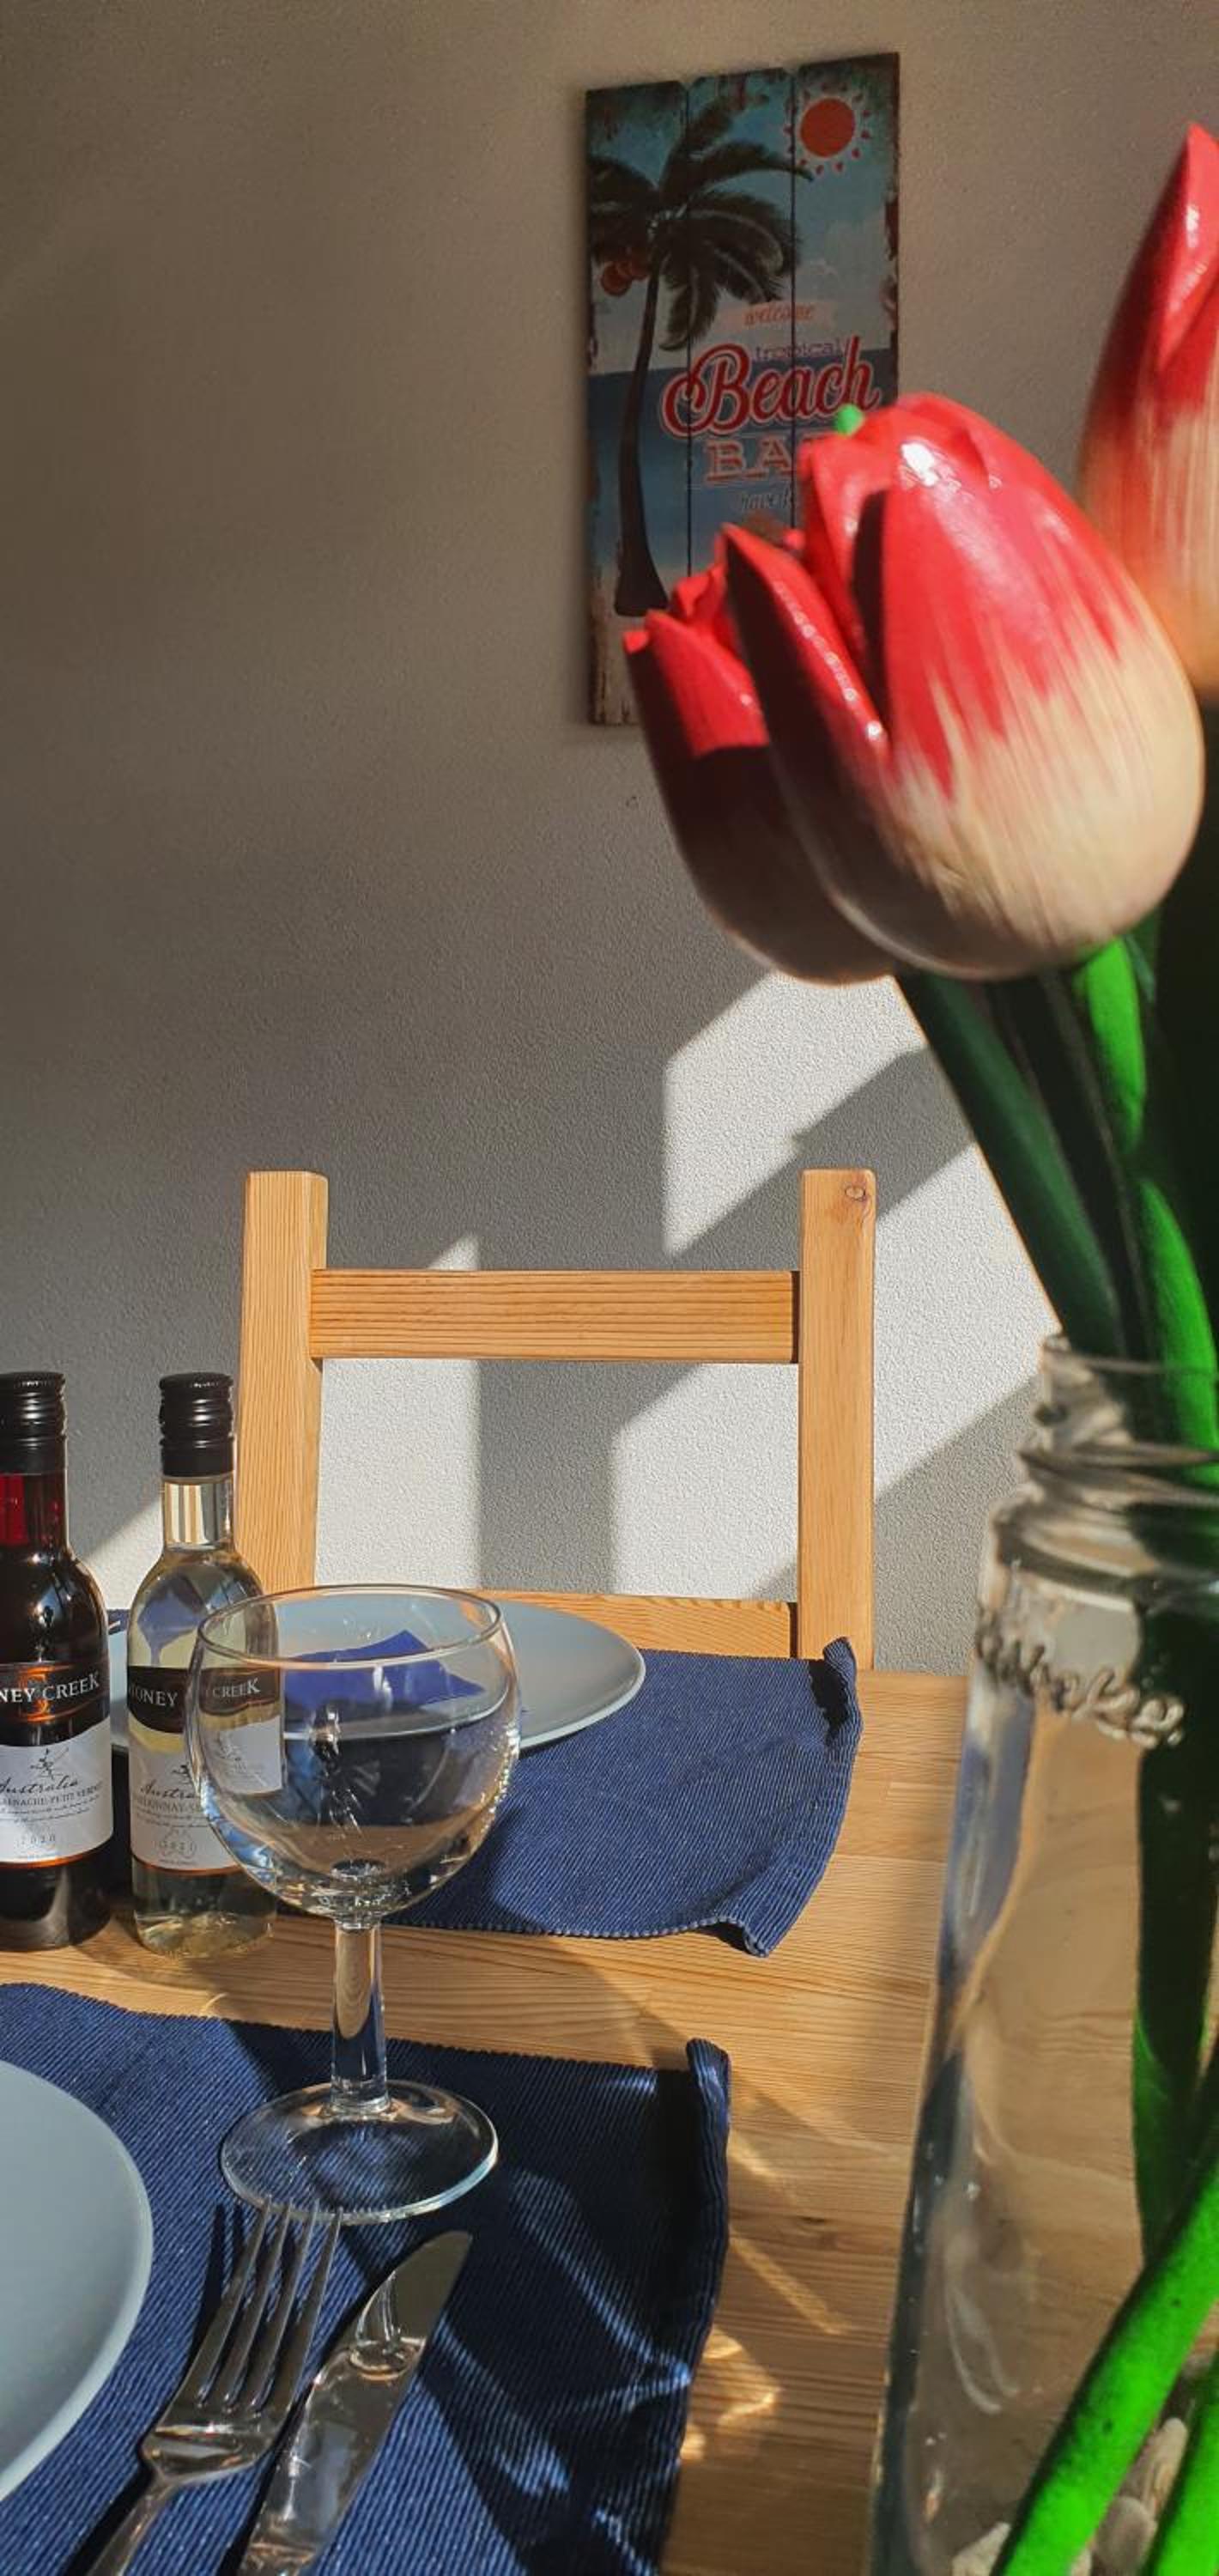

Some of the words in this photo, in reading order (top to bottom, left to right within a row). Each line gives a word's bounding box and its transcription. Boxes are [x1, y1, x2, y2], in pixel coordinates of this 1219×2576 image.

[744, 301, 816, 326] welcome
[661, 334, 881, 438] Beach
[705, 434, 805, 485] BA
[0, 1687, 35, 1703] NEY
[42, 1669, 100, 1700] CREEK
[212, 1676, 261, 1698] CREEK
[141, 1778, 196, 1799] Austra
